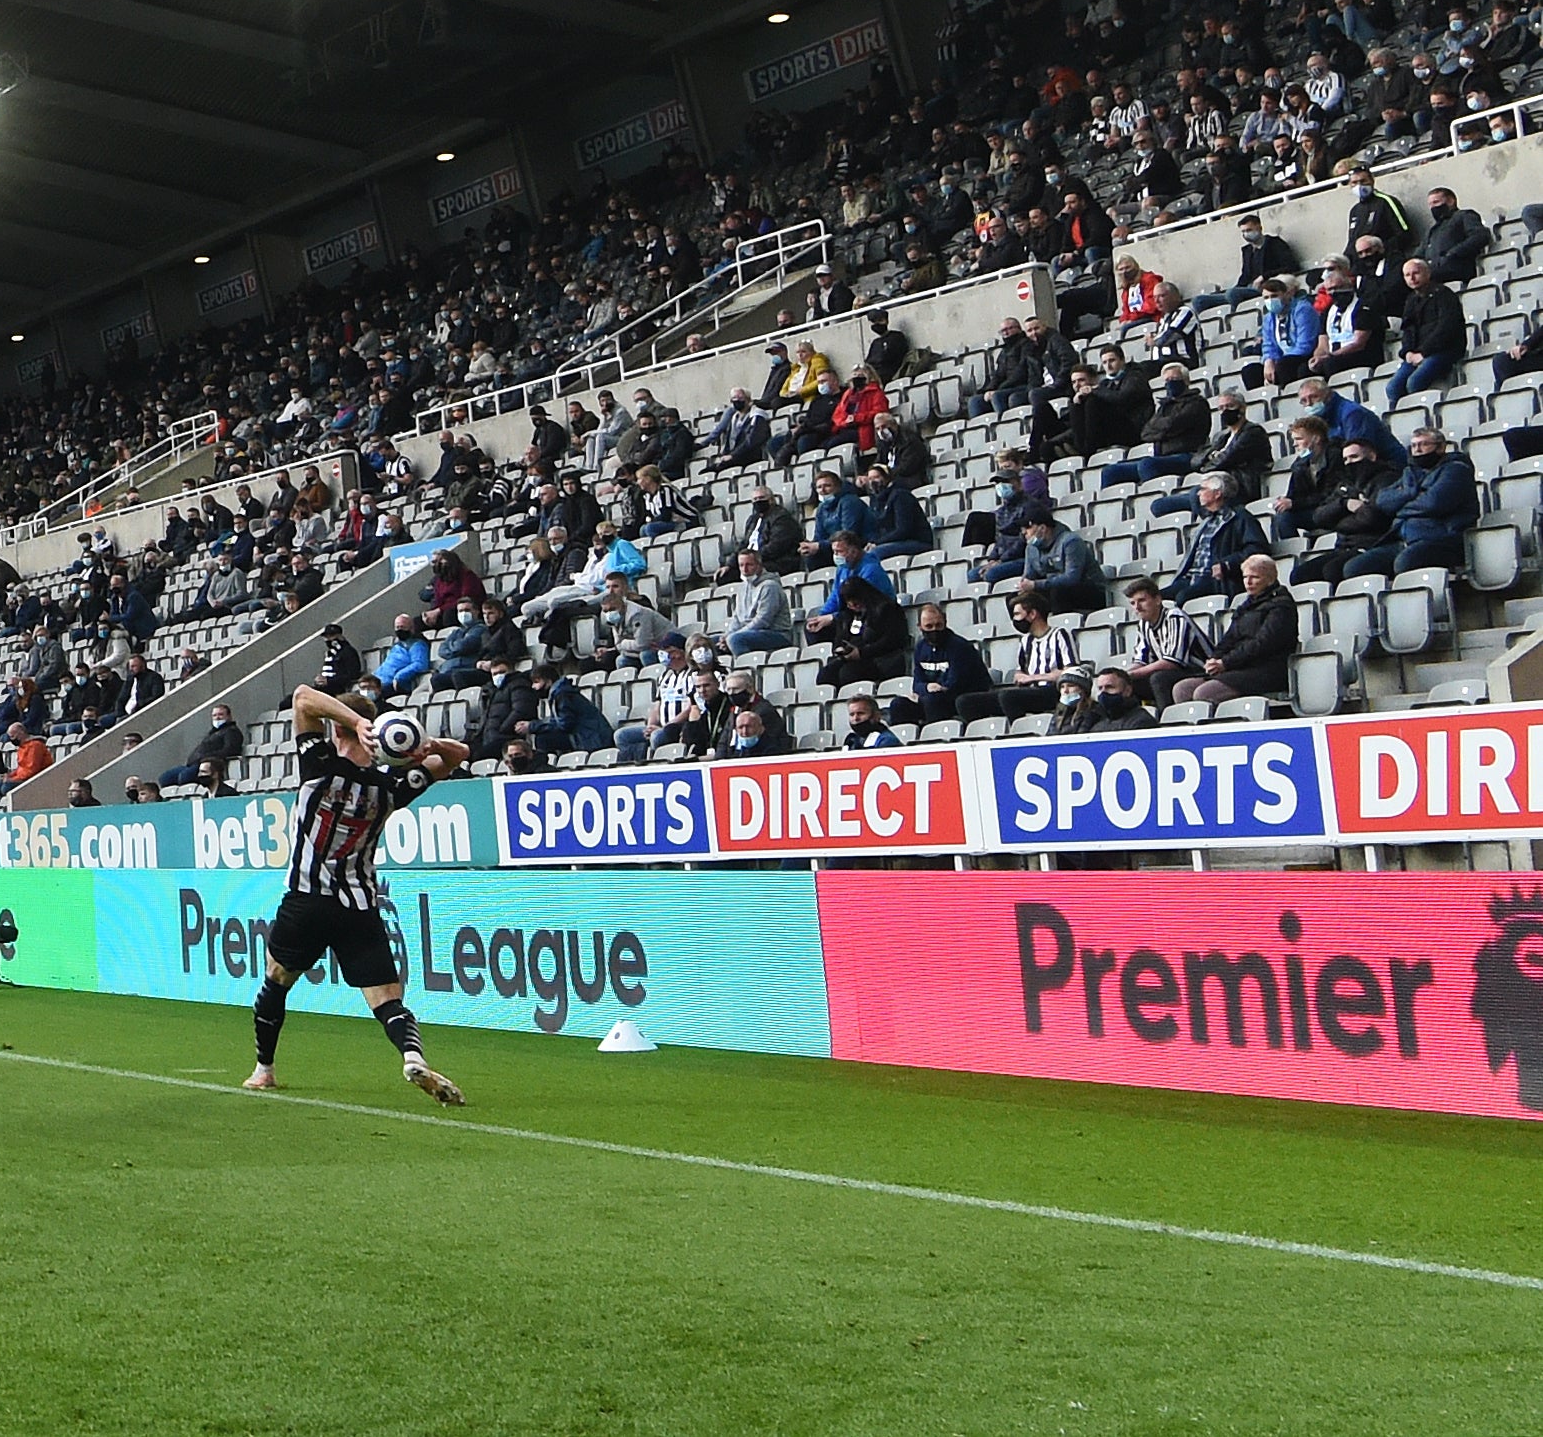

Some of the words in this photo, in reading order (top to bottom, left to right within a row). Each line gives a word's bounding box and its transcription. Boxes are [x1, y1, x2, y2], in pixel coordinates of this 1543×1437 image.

[755, 46, 830, 95] SPORTS
[583, 124, 646, 163] SPORTS
[436, 186, 492, 220] SPORTS
[309, 233, 356, 268] SPORTS
[201, 279, 244, 311] SPORTS
[516, 778, 695, 850] SPORTS
[727, 763, 943, 842] DIRECT
[1013, 740, 1303, 833] SPORTS
[313, 808, 372, 861] 17
[417, 892, 649, 1035] League
[1014, 901, 1436, 1060] Premier
